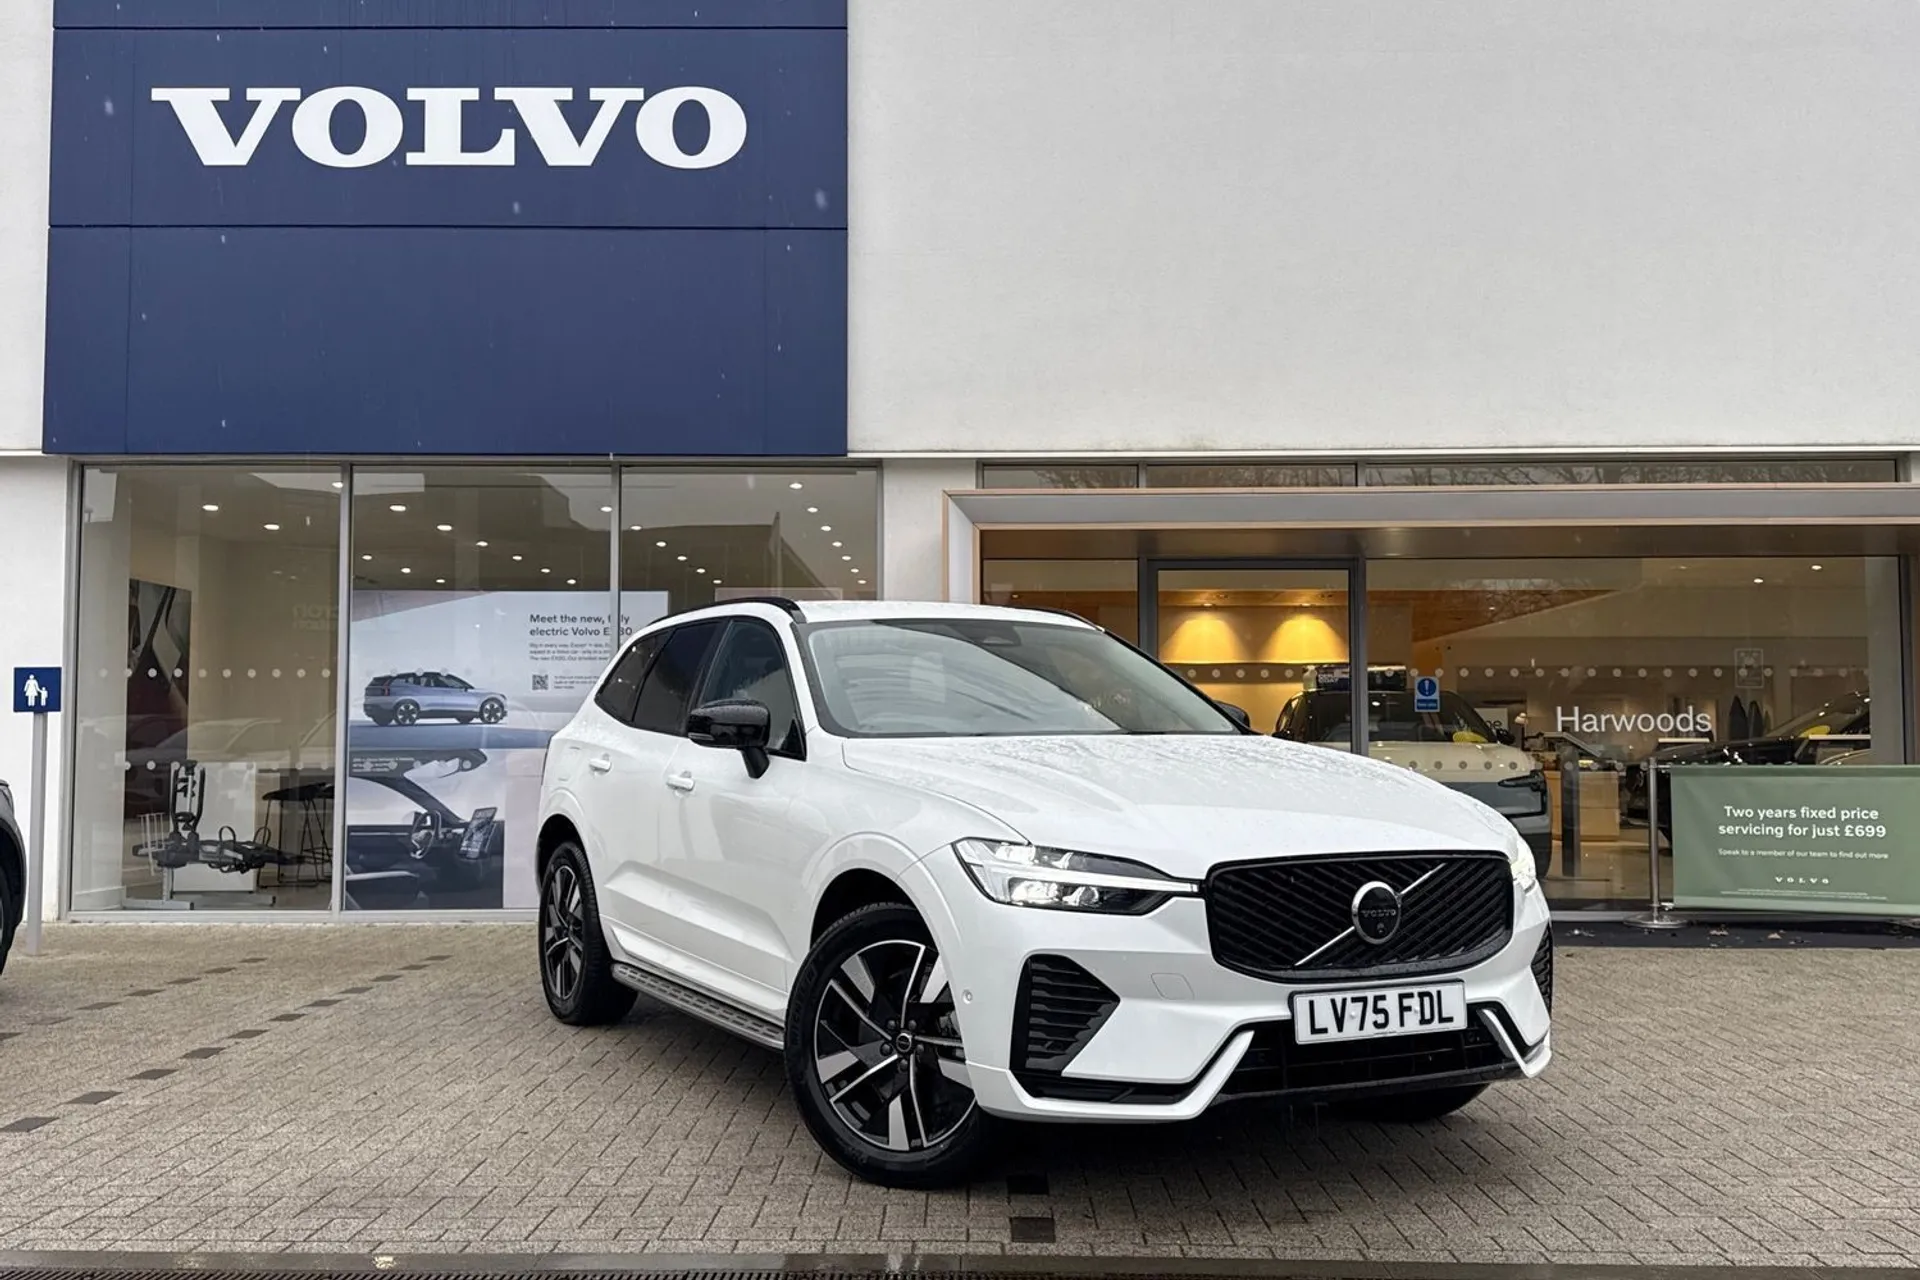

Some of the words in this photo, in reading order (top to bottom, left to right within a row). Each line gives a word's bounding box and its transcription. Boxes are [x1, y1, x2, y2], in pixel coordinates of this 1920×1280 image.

[151, 86, 747, 169] VOLVO
[530, 614, 557, 623] Meet
[560, 614, 577, 623] the
[580, 616, 604, 625] new,
[530, 627, 568, 636] electric
[572, 627, 600, 636] Volvo
[1556, 705, 1712, 732] Harwoods
[1724, 805, 1754, 818] Two
[1757, 808, 1797, 821] years
[1800, 806, 1836, 819] fixed
[1840, 807, 1879, 822] price
[1718, 823, 1784, 838] servicing
[1788, 823, 1809, 836] for
[1811, 824, 1840, 839] just
[1844, 825, 1887, 838] £699
[1718, 848, 1741, 857] Speak
[1756, 849, 1786, 858] member
[1787, 849, 1795, 857] of
[1809, 850, 1828, 858] team
[1830, 850, 1838, 858] to
[1839, 850, 1853, 859] find
[1854, 852, 1867, 860] out
[1869, 852, 1889, 860] more
[1775, 876, 1829, 884] VOLVO
[1361, 909, 1396, 918] VOLVO
[1309, 995, 1389, 1034] LV75
[1398, 990, 1454, 1027] FDL
